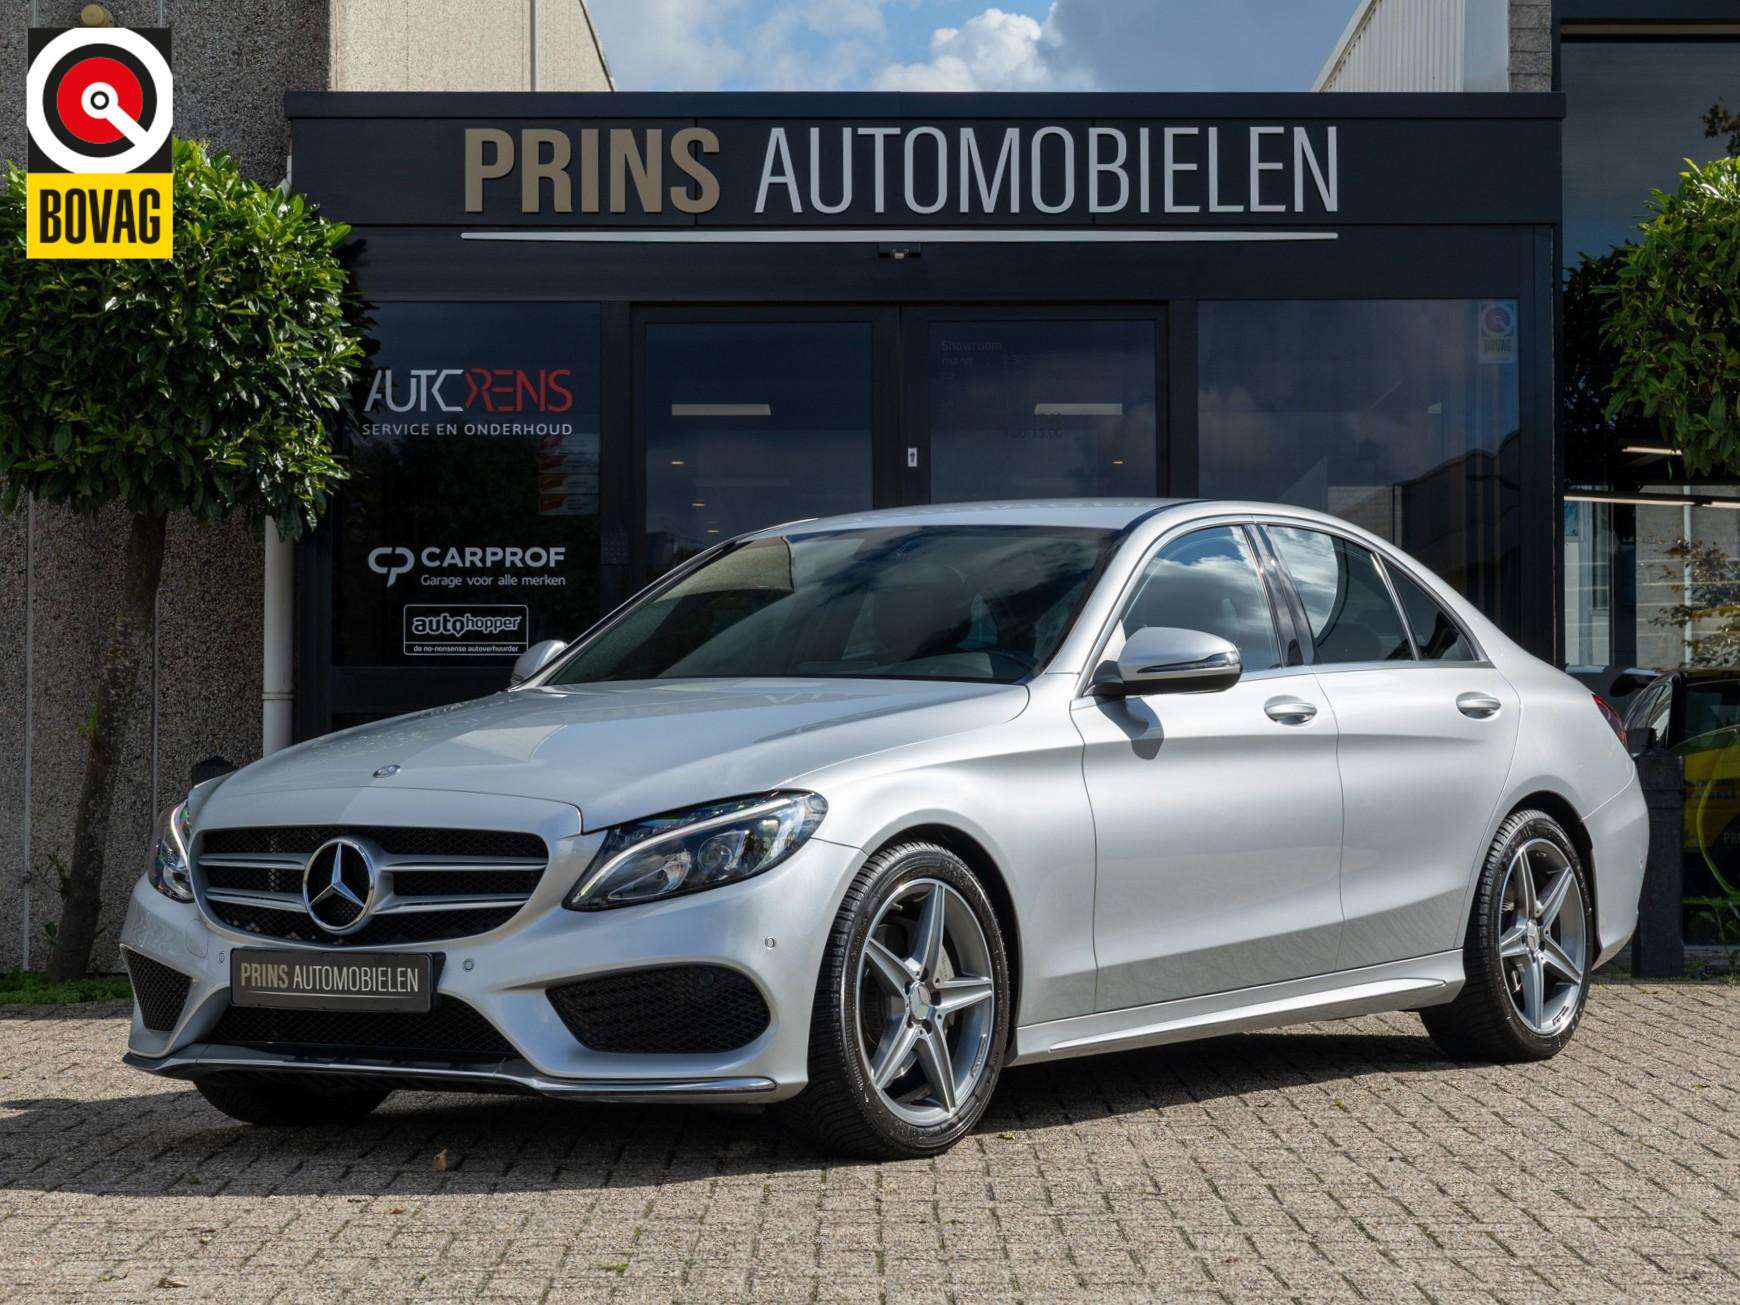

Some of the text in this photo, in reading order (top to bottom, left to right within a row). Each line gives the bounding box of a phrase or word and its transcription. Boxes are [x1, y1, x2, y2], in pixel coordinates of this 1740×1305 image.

[464, 125, 1339, 214] PRINS AUTOMOBIELEN
[362, 422, 573, 436] SERVICE EN ONDERHOUD
[420, 547, 566, 568] CARPROF
[420, 574, 566, 588] Garage voor alle merken
[412, 613, 522, 638] autohopper
[423, 645, 467, 653] no-nonsense
[240, 962, 420, 993] PRINS AUTOMOBIELEN
